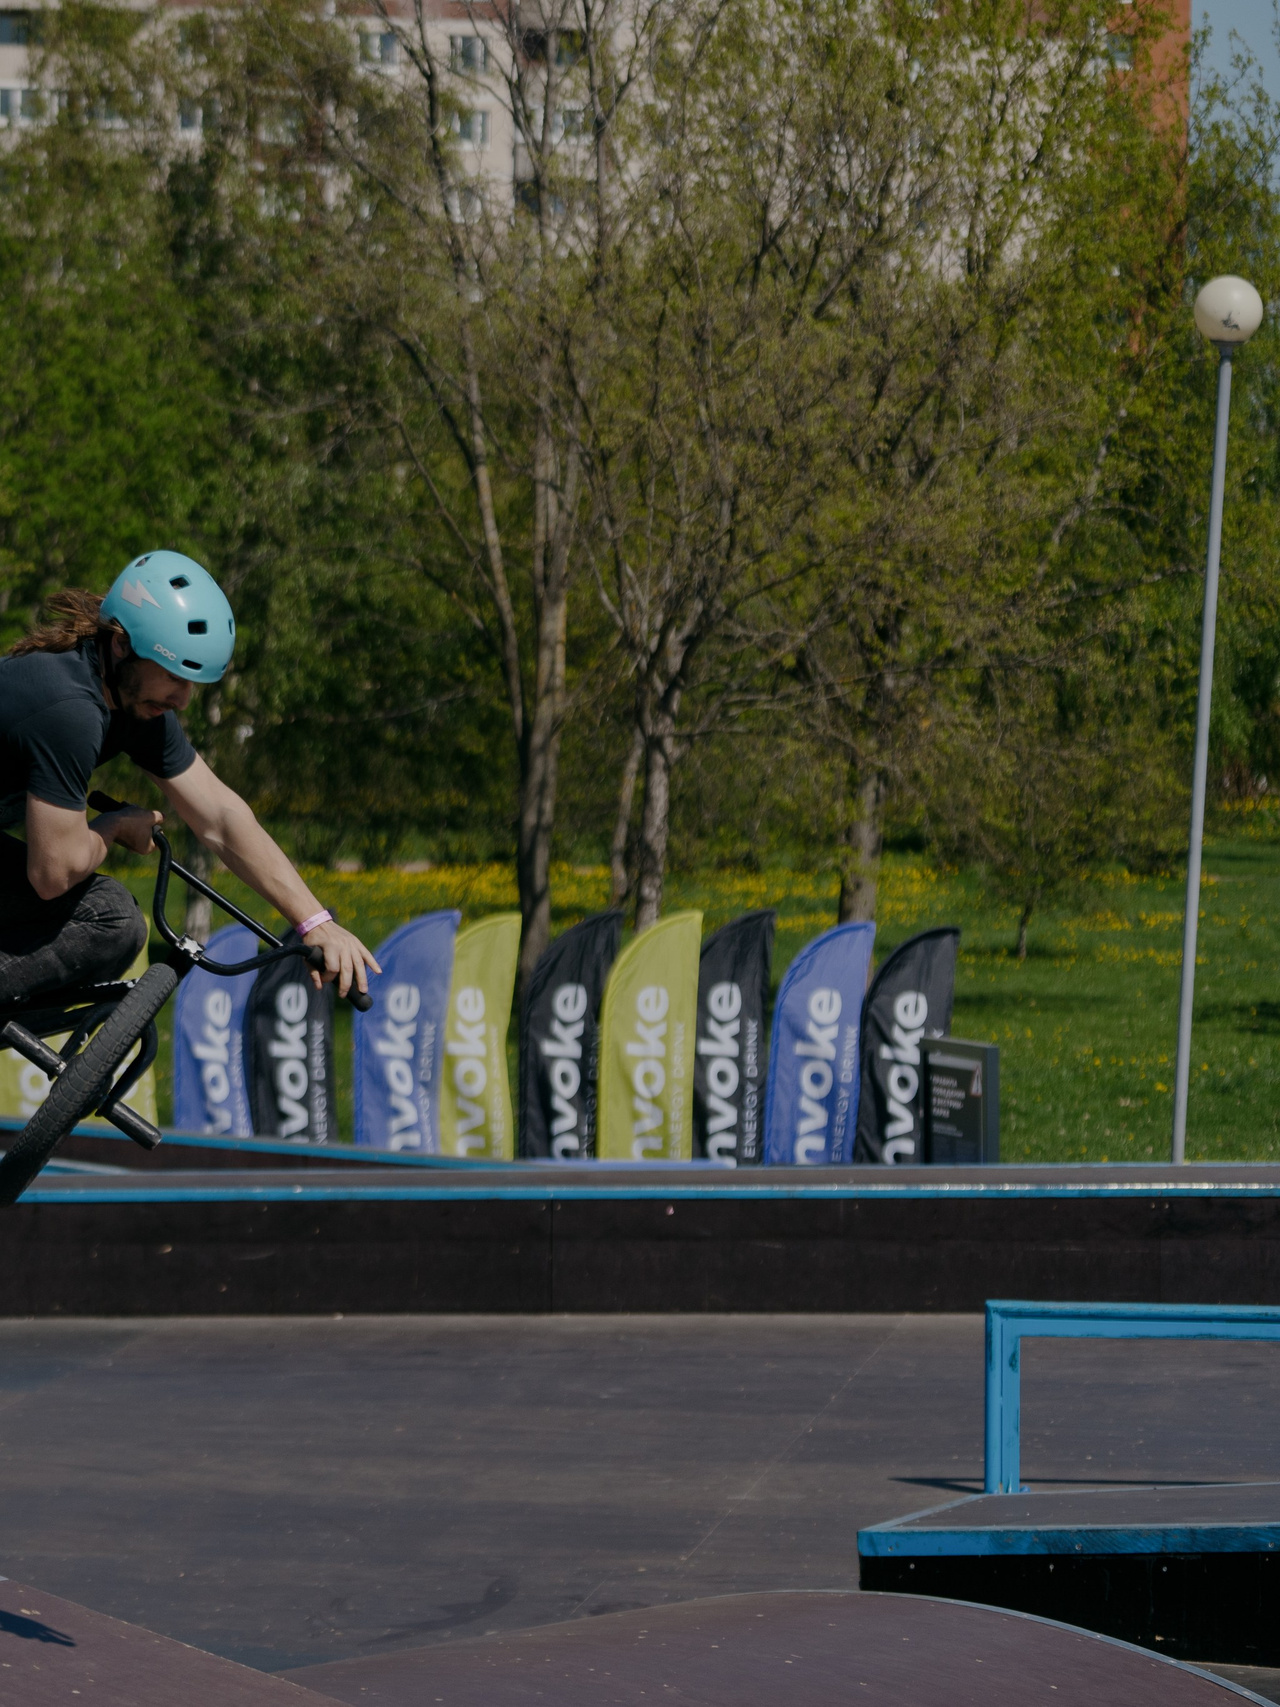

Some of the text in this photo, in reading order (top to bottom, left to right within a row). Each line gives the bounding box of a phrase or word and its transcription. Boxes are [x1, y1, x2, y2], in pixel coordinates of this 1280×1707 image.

[269, 983, 308, 1143] voke
[698, 982, 742, 1169] nvoke
[745, 1019, 759, 1158] ENERGY DRINK
[832, 1026, 858, 1162] ENERGY DRINK
